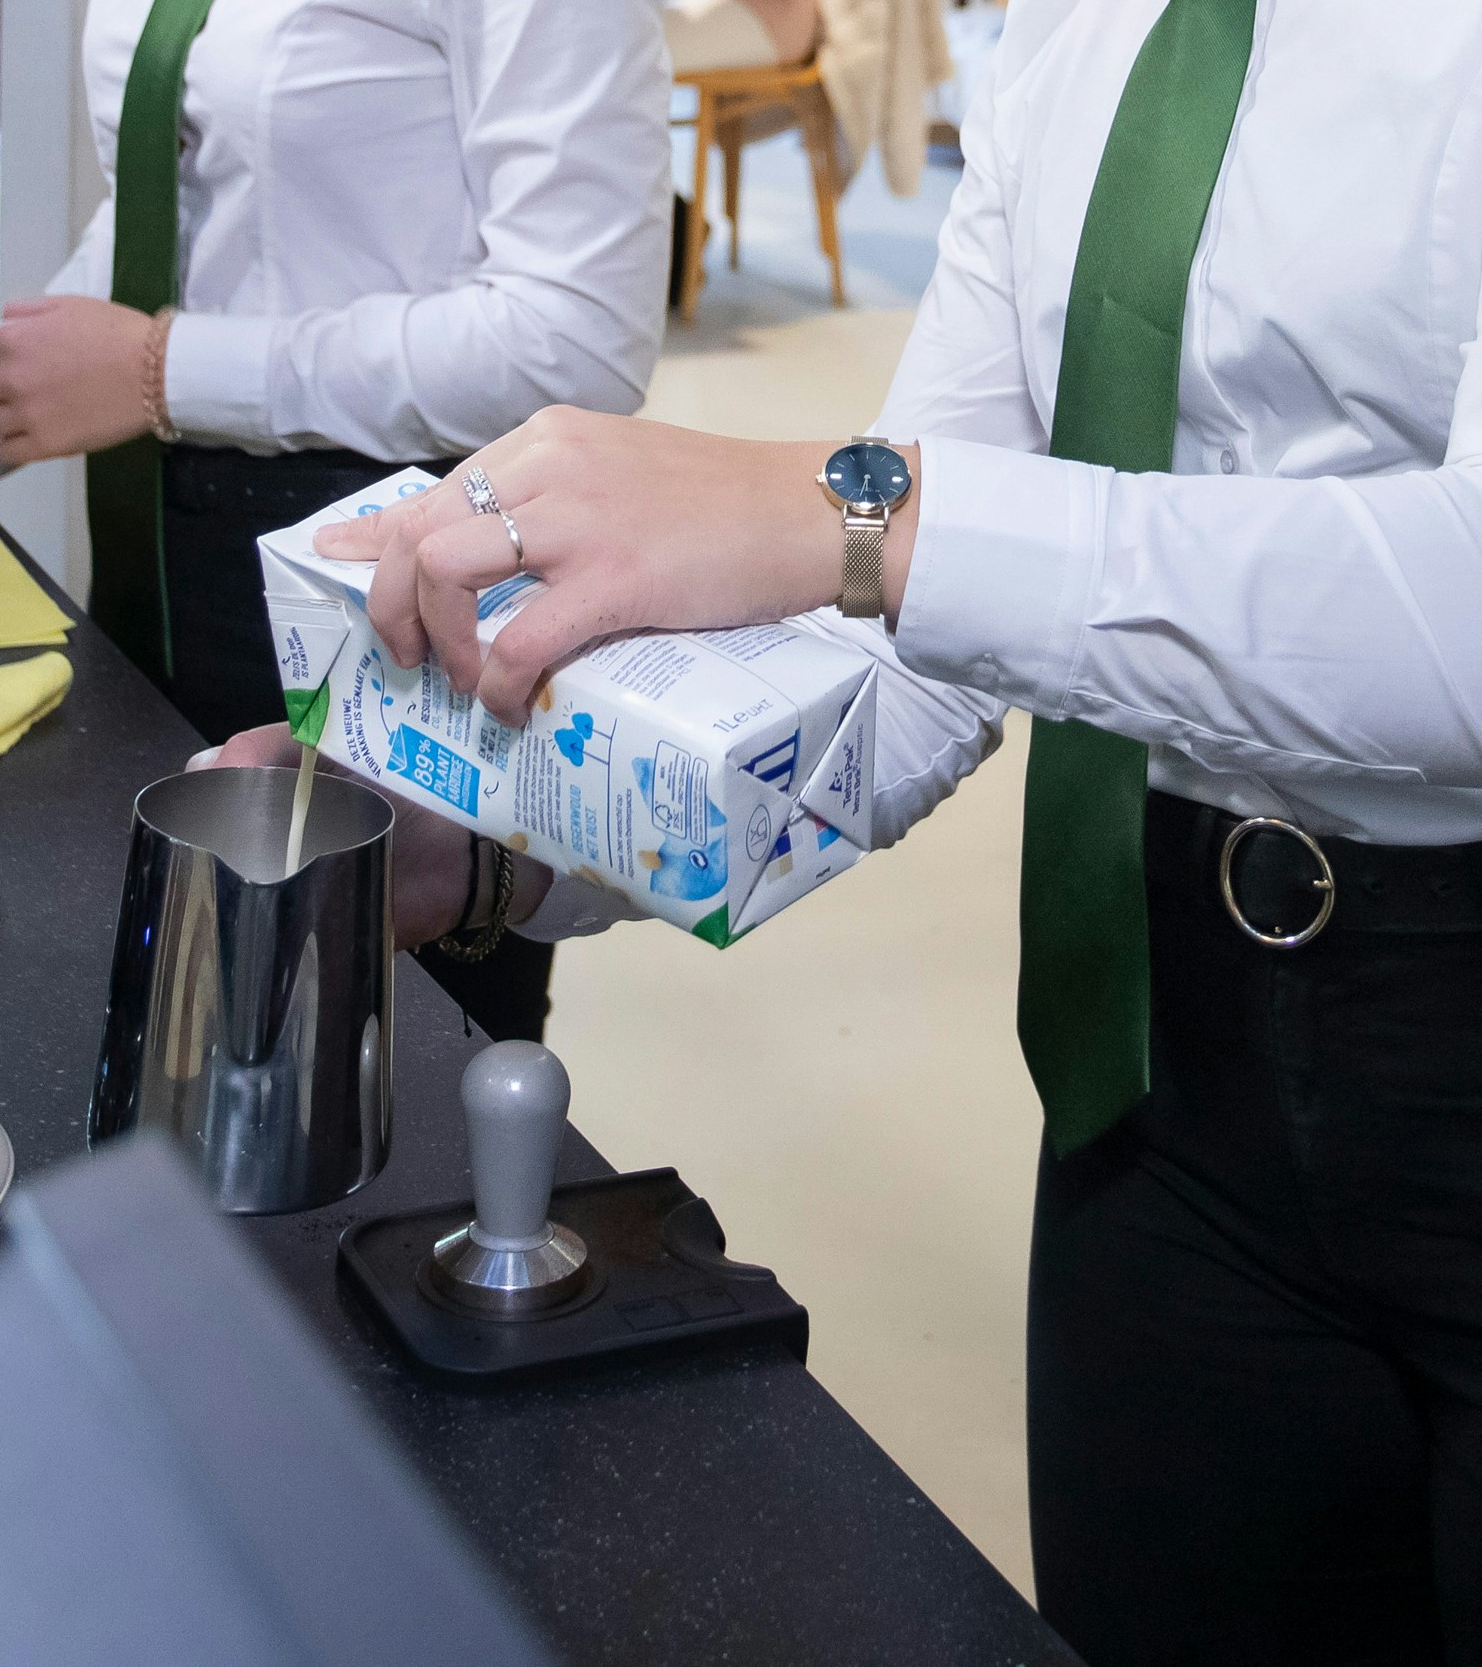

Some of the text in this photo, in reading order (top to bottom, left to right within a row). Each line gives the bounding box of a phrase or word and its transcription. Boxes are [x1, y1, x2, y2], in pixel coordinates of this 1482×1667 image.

[287, 637, 296, 650] DOP
[292, 659, 300, 680] ZELFS
[301, 670, 309, 678] IS
[353, 653, 382, 778] VERPAKKING IS GEMAAKT VAN
[421, 665, 431, 724] RESULTEREND
[343, 698, 360, 762] DEZE NIEUWE
[413, 739, 434, 787] 89%
[434, 748, 451, 796] PLANT
[448, 757, 464, 804] AARDIGE
[843, 773, 854, 808] Tetra
[853, 789, 861, 817] Tetra
[571, 784, 583, 853] REGENWOUD
[587, 839, 599, 862] MET
